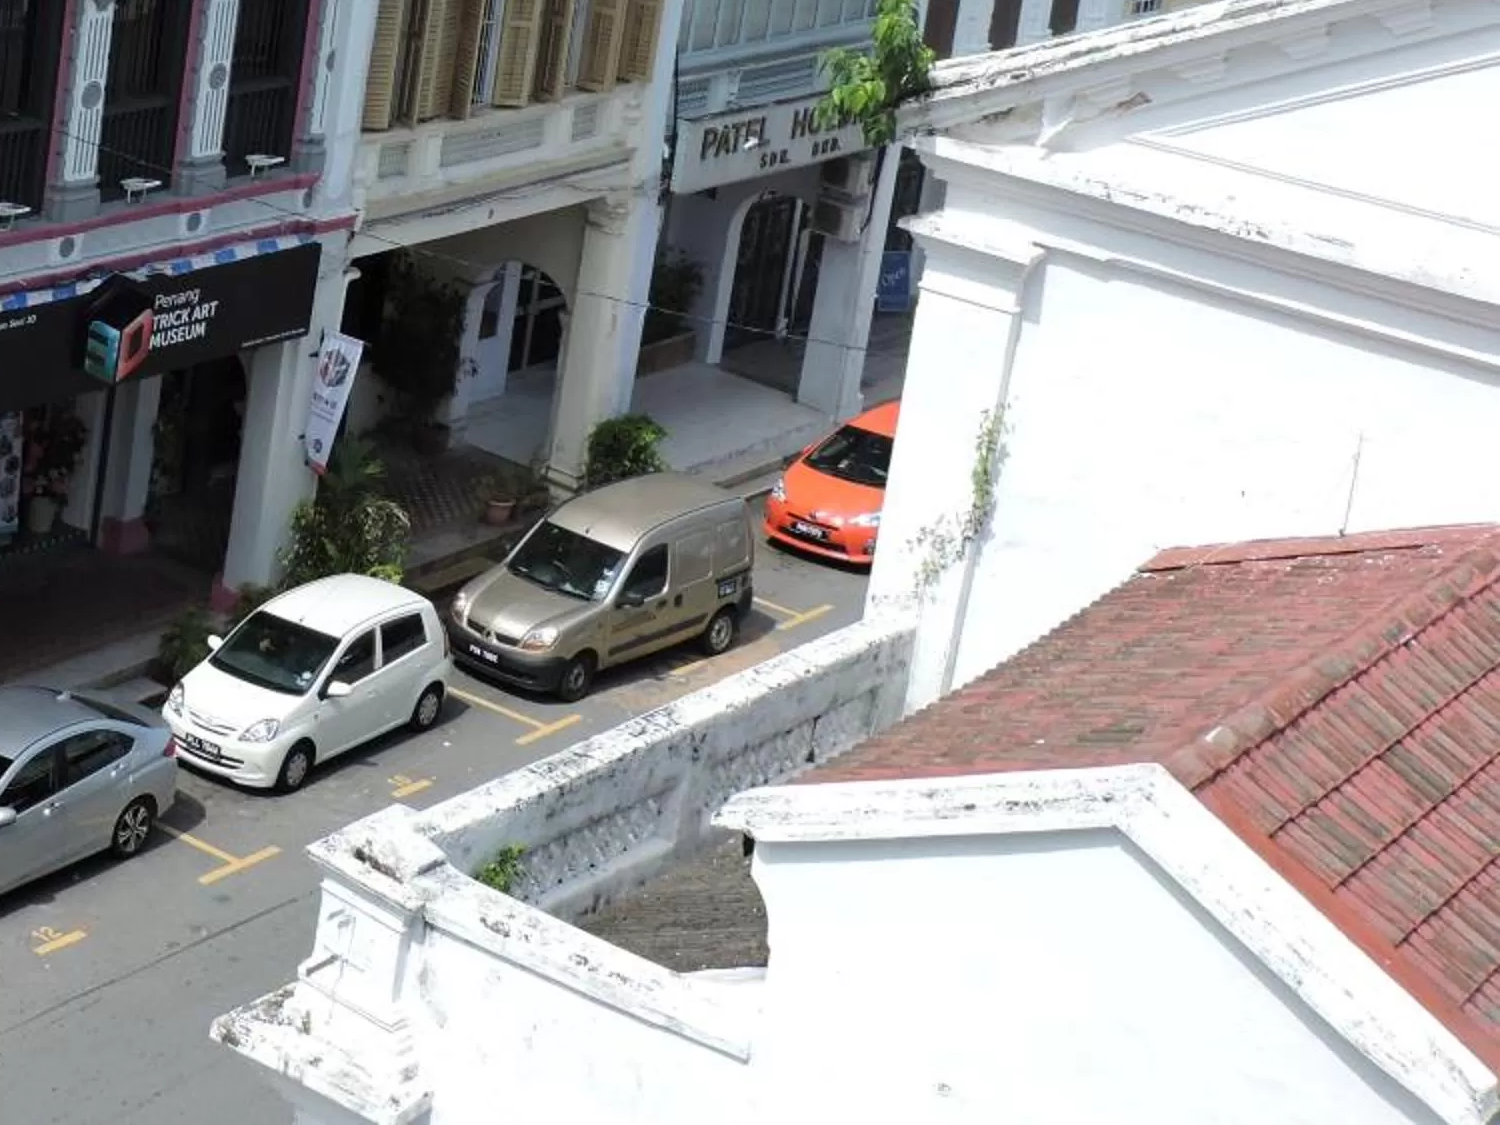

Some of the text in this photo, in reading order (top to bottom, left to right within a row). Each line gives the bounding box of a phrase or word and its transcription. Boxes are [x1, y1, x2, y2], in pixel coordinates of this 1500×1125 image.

[155, 288, 201, 309] Penang
[153, 300, 219, 332] TRICK ART
[148, 322, 206, 351] MUSEUM
